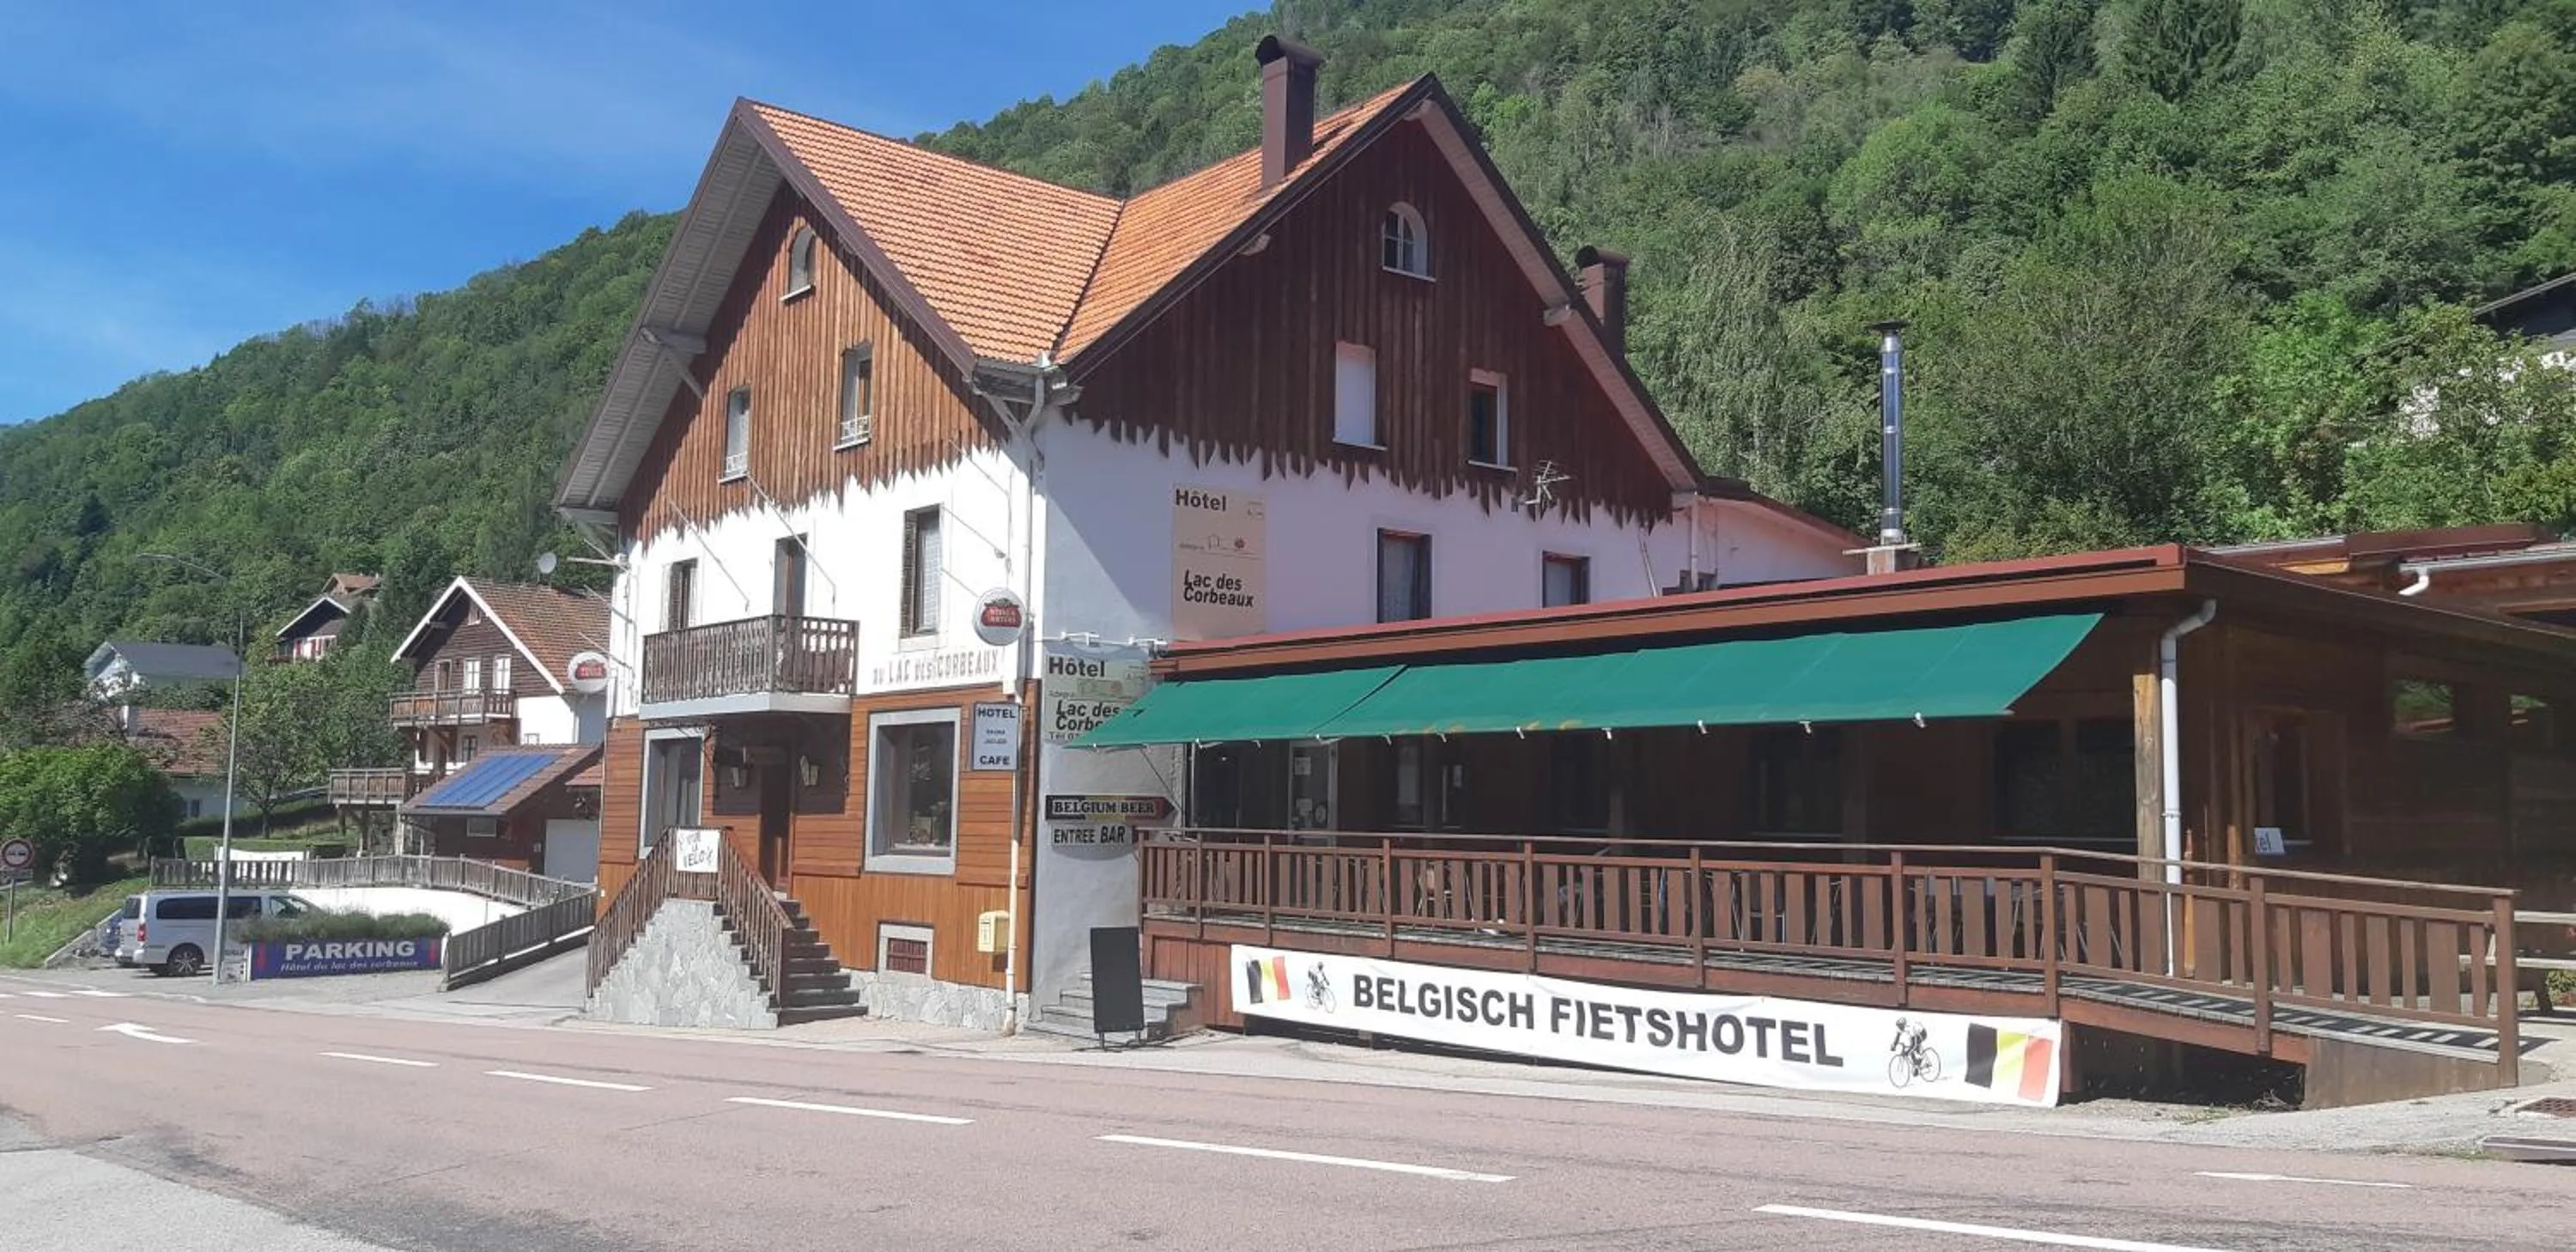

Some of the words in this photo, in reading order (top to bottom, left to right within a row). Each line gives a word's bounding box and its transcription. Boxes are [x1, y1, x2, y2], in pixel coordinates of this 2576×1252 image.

[1176, 489, 1227, 512] Hôtel
[1184, 568, 1212, 588] Lac
[1216, 574, 1242, 591] des
[1183, 586, 1255, 608] Corbeaux
[889, 659, 910, 684] LAC
[937, 649, 999, 678] CORBEAUX
[1048, 657, 1105, 678] Hôtel
[977, 707, 1017, 719] HOTEL
[1055, 699, 1087, 717] Lac
[1091, 702, 1121, 718] des
[1054, 801, 1115, 814] BELGIUM
[1121, 801, 1155, 813] BEER
[1054, 828, 1096, 844] ENTREE
[1100, 825, 1126, 844] BAR
[284, 940, 416, 961] PARKING
[1353, 973, 1535, 1030] BELGISCH
[1550, 996, 1844, 1067] FIETSHOTEL
